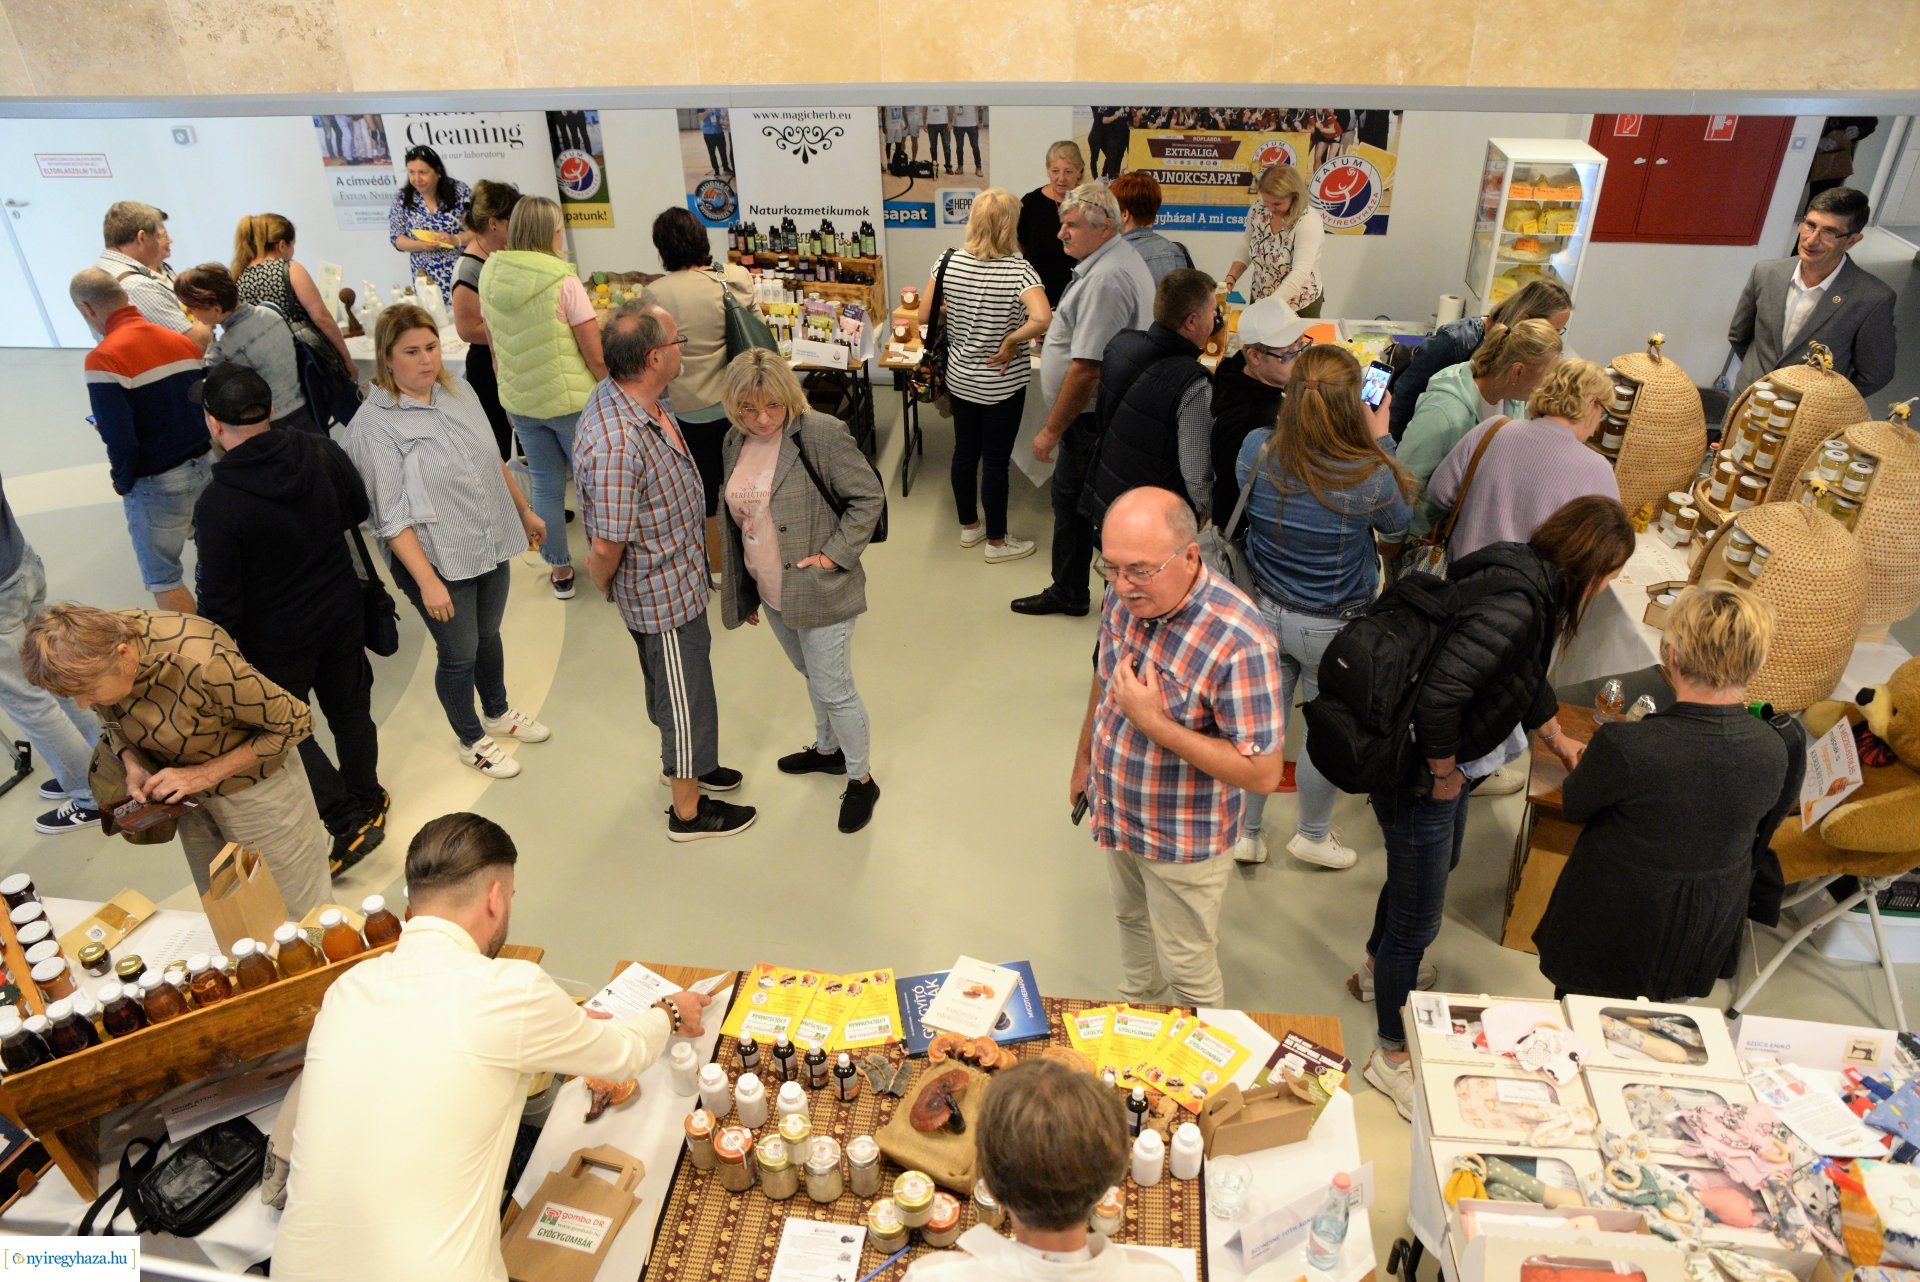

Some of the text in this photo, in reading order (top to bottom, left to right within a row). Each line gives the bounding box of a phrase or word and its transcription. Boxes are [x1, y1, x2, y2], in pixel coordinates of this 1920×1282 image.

[752, 110, 852, 122] www.magicherb.eu
[405, 119, 524, 149] Cleaning
[441, 150, 506, 162] is our laboratory
[1165, 147, 1219, 158] EXTRALIGA
[1315, 158, 1363, 183] FATUM
[336, 177, 345, 186] A
[346, 174, 391, 186] címvédő
[749, 205, 870, 216] Naturkozmetikumok
[1197, 213, 1207, 223] A
[1209, 213, 1224, 224] mi
[911, 985, 935, 1039] GYGYÍTÓ
[561, 1210, 592, 1225] gomba
[536, 1226, 594, 1249] GYÓGYGOMBÁK
